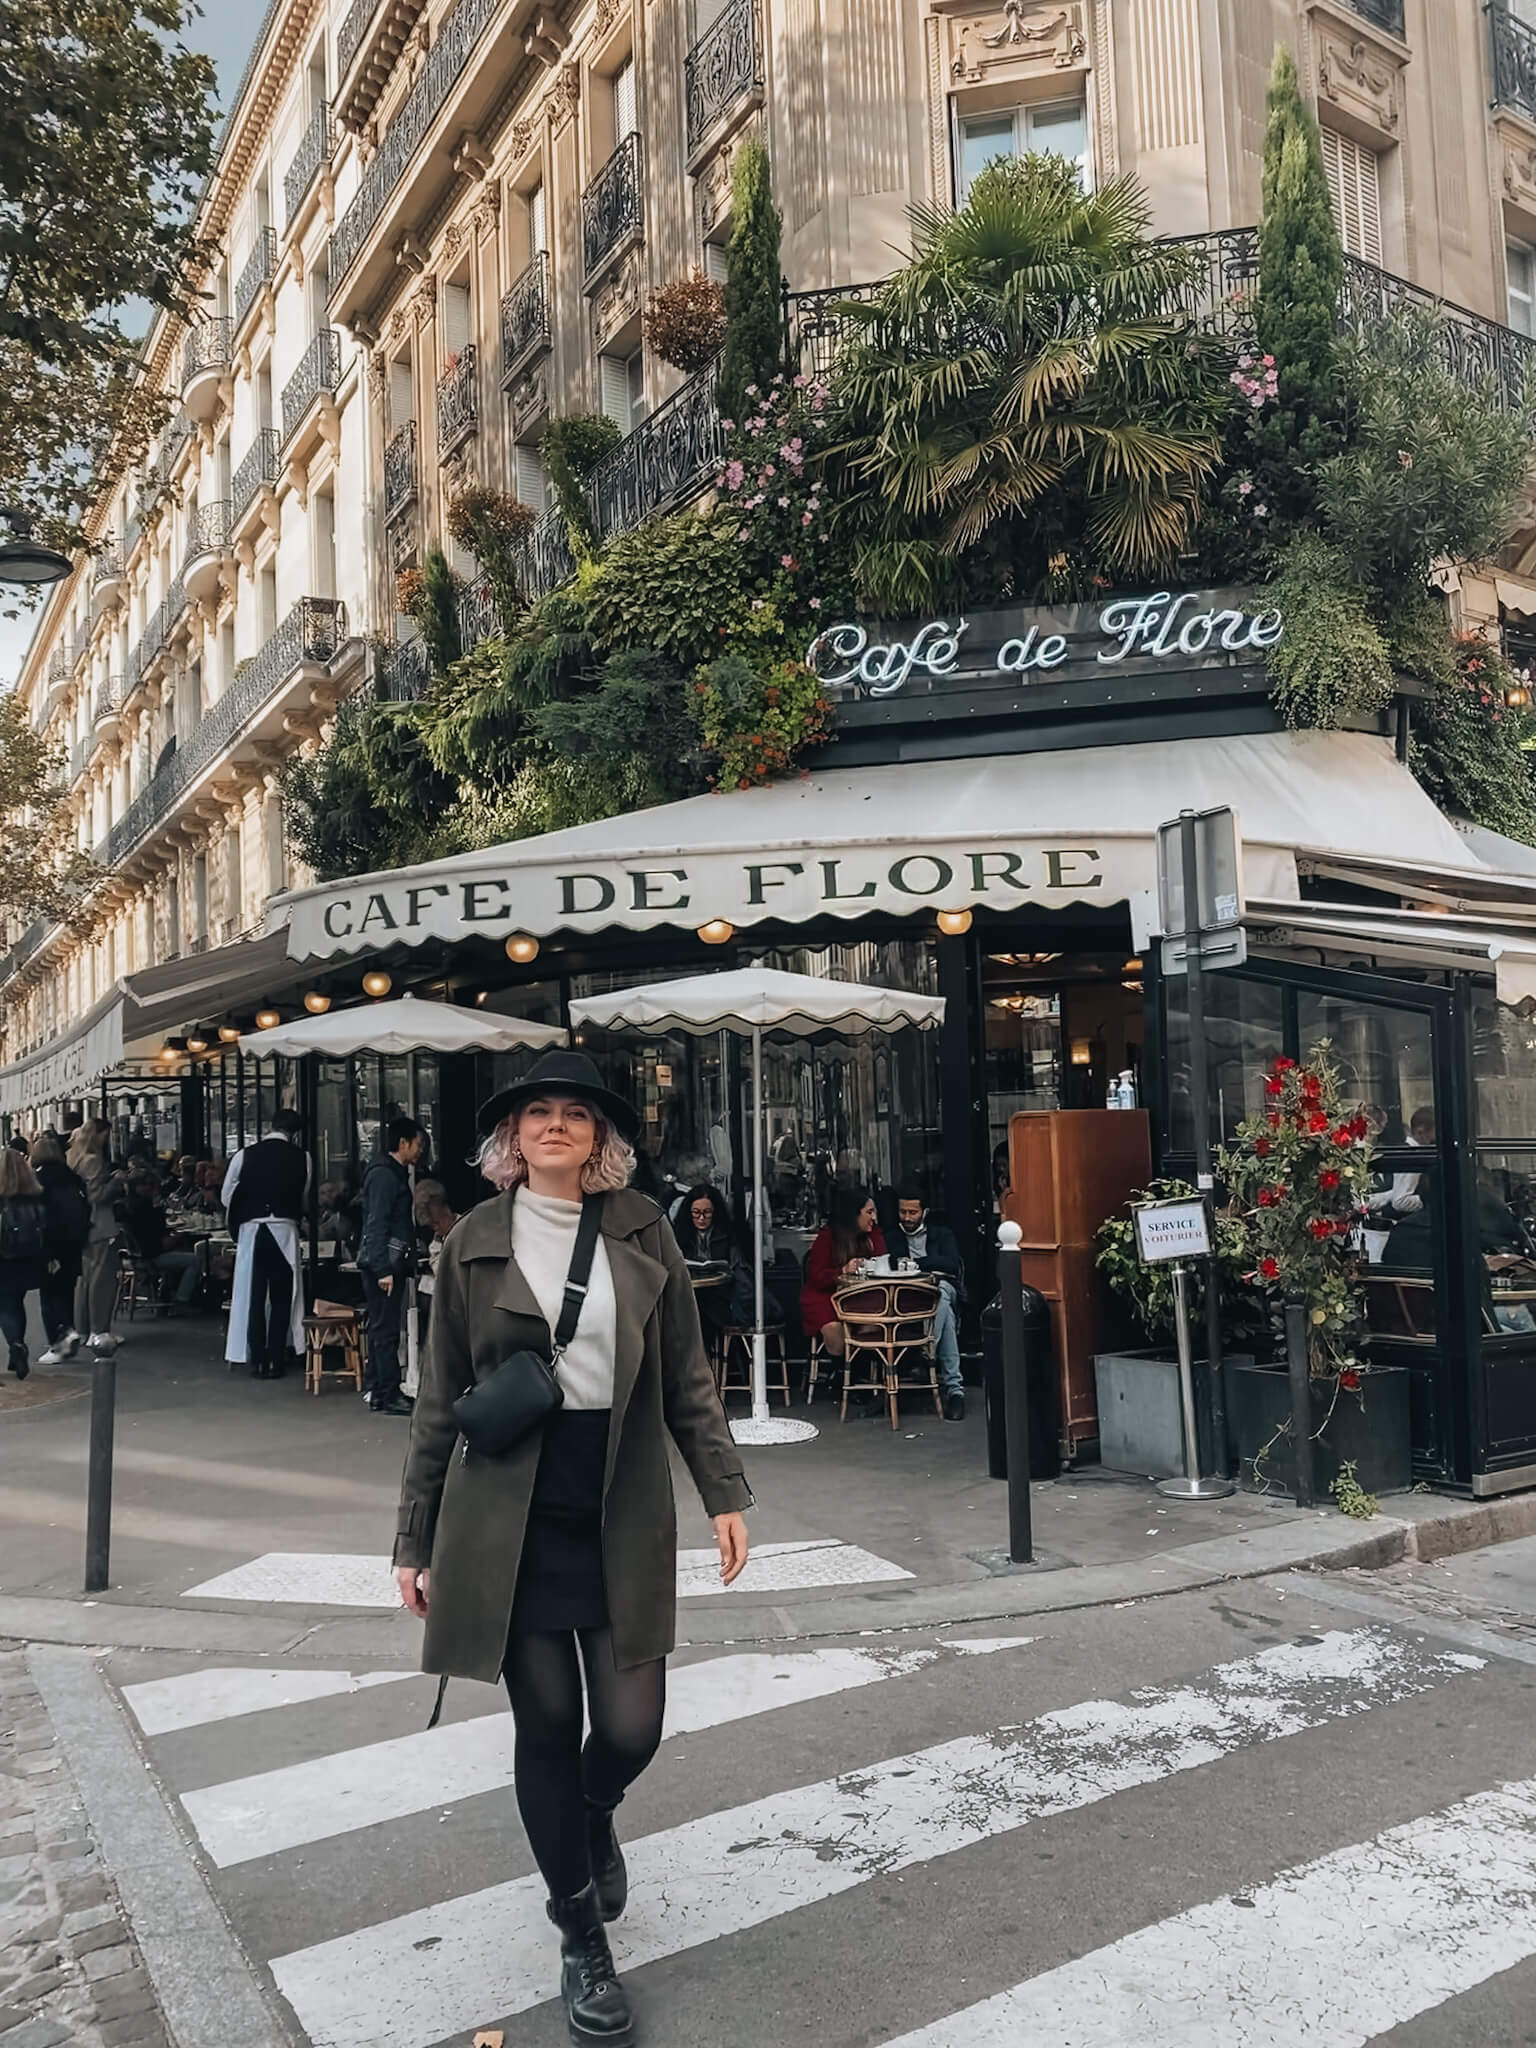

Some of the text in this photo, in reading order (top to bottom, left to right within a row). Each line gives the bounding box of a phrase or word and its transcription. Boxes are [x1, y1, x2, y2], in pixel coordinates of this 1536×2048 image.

[805, 591, 1286, 697] Café de Flore
[323, 849, 1104, 938] CAFE DE FLORE
[1147, 1219, 1196, 1231] SERVICE
